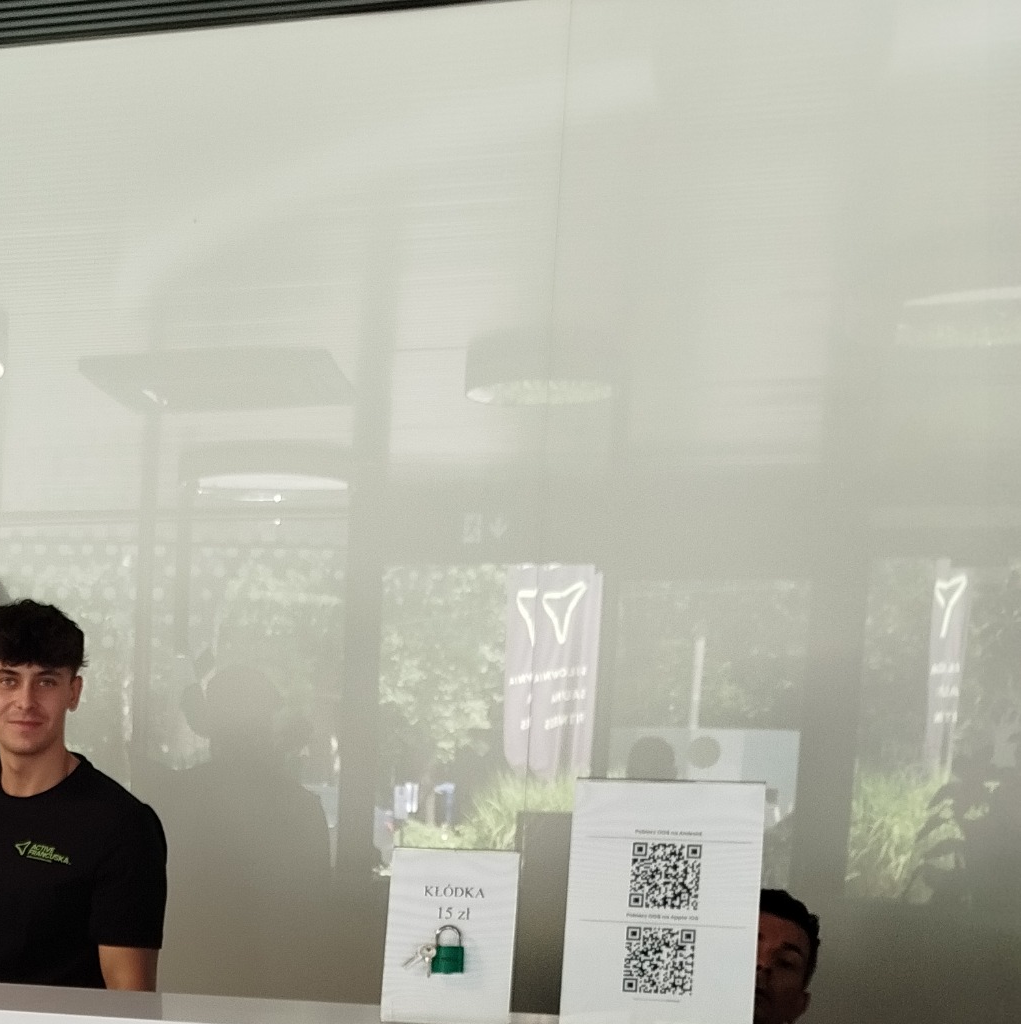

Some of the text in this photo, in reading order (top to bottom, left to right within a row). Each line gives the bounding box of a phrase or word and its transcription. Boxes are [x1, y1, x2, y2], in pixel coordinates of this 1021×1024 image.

[30, 844, 55, 854] ACTIVE
[27, 849, 69, 864] FRANCUSKA
[424, 884, 485, 899] KŁÓDKA
[438, 907, 453, 920] 15
